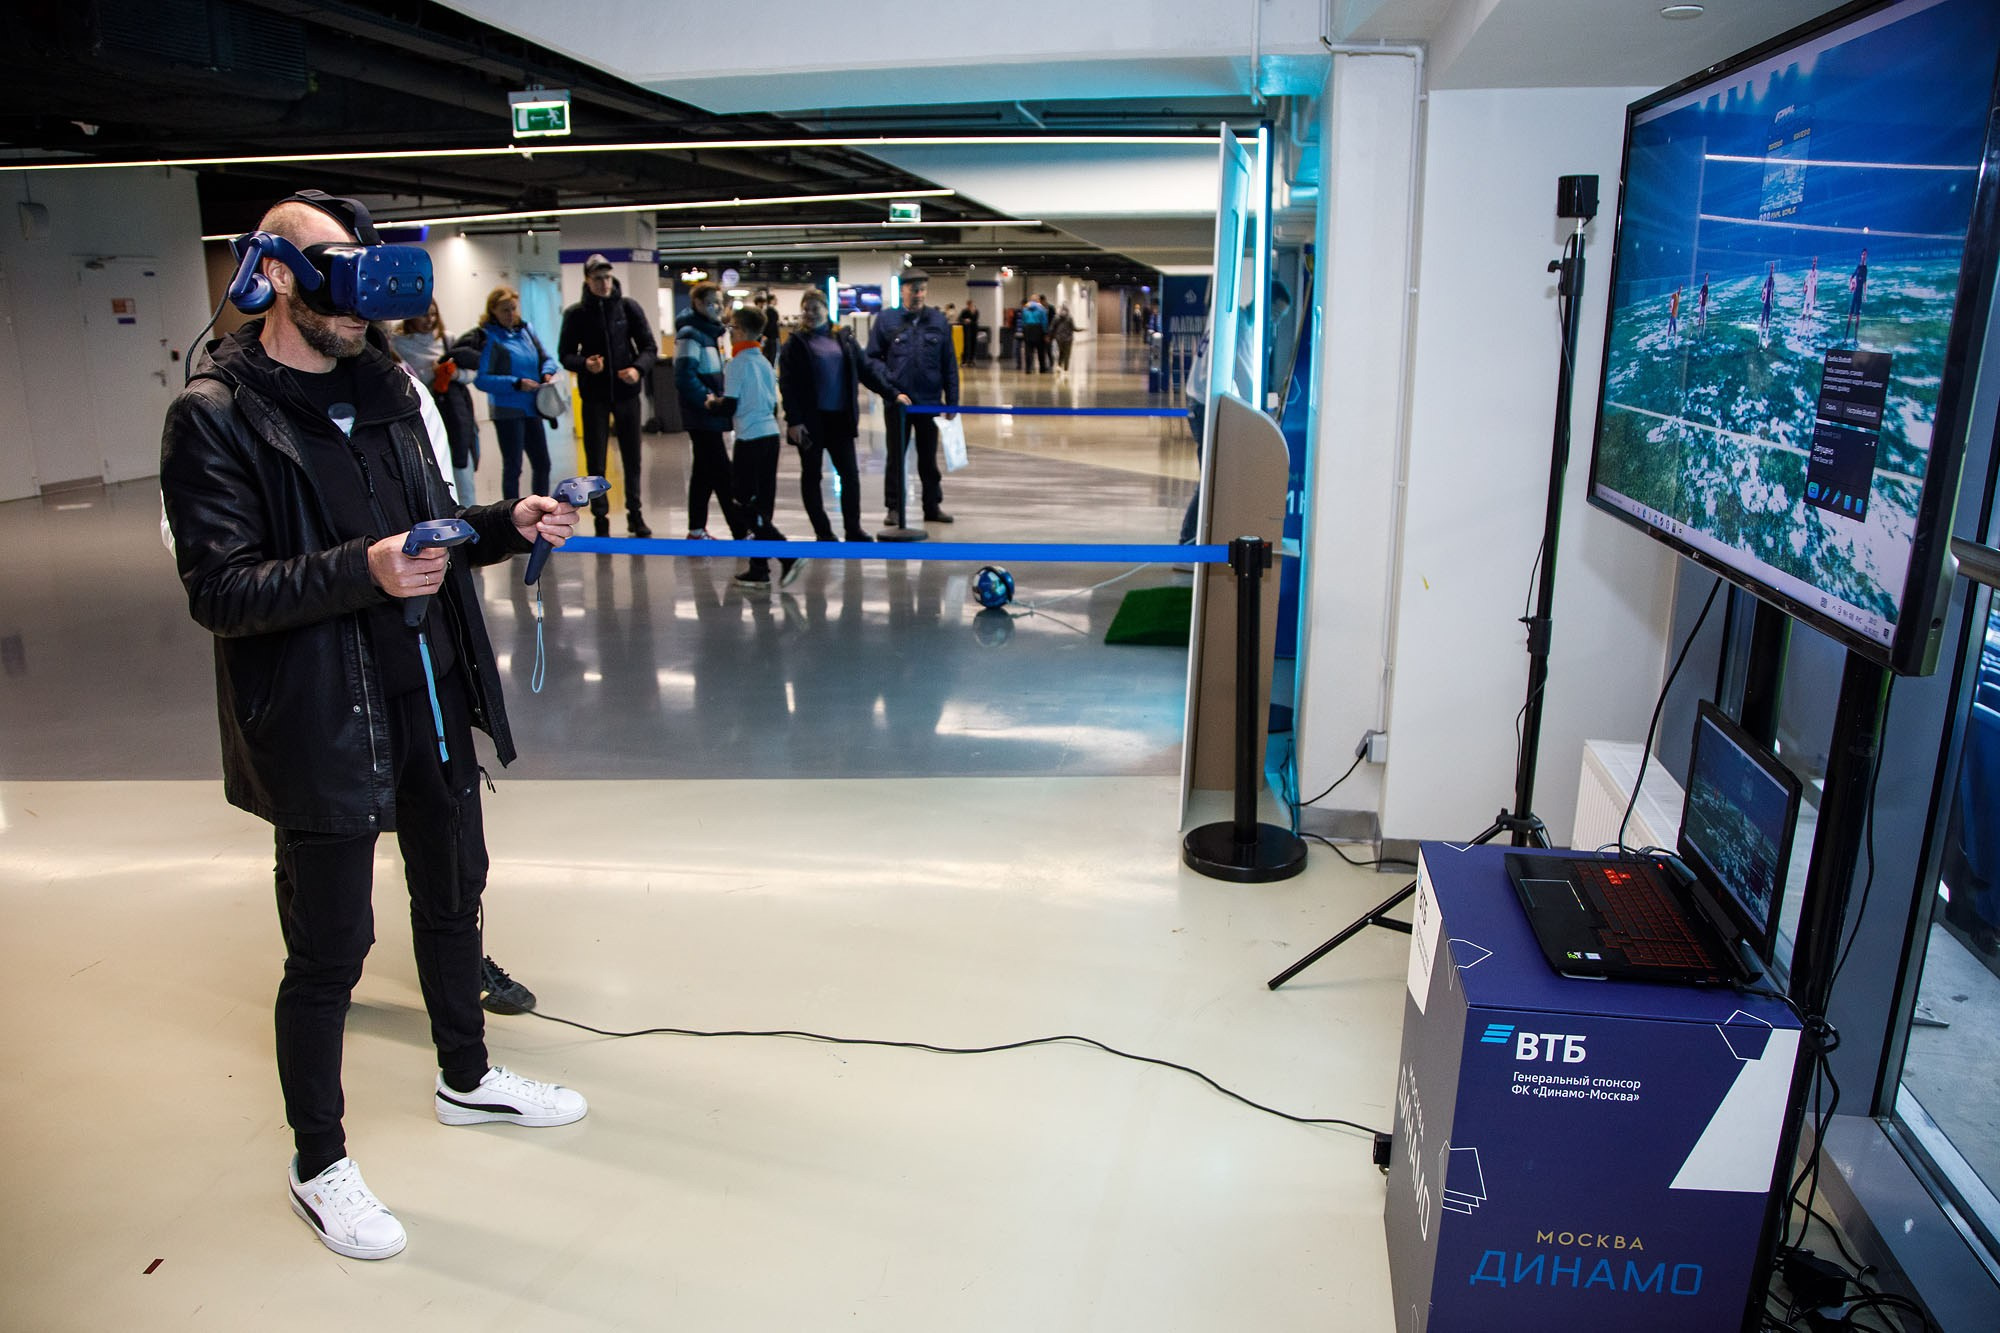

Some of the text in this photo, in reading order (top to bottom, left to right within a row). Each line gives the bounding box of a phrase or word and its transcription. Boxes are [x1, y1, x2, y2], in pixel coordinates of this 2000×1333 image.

[1515, 1032, 1587, 1064] ВТБ
[1511, 1084, 1640, 1102] ФК «Динамо-Москва»
[1513, 1071, 1642, 1092] Генеральный спонсор
[1400, 1063, 1431, 1242] ДИНАМО
[1536, 1230, 1645, 1251] МОСКВА
[1469, 1249, 1704, 1296] ДИНАМО
